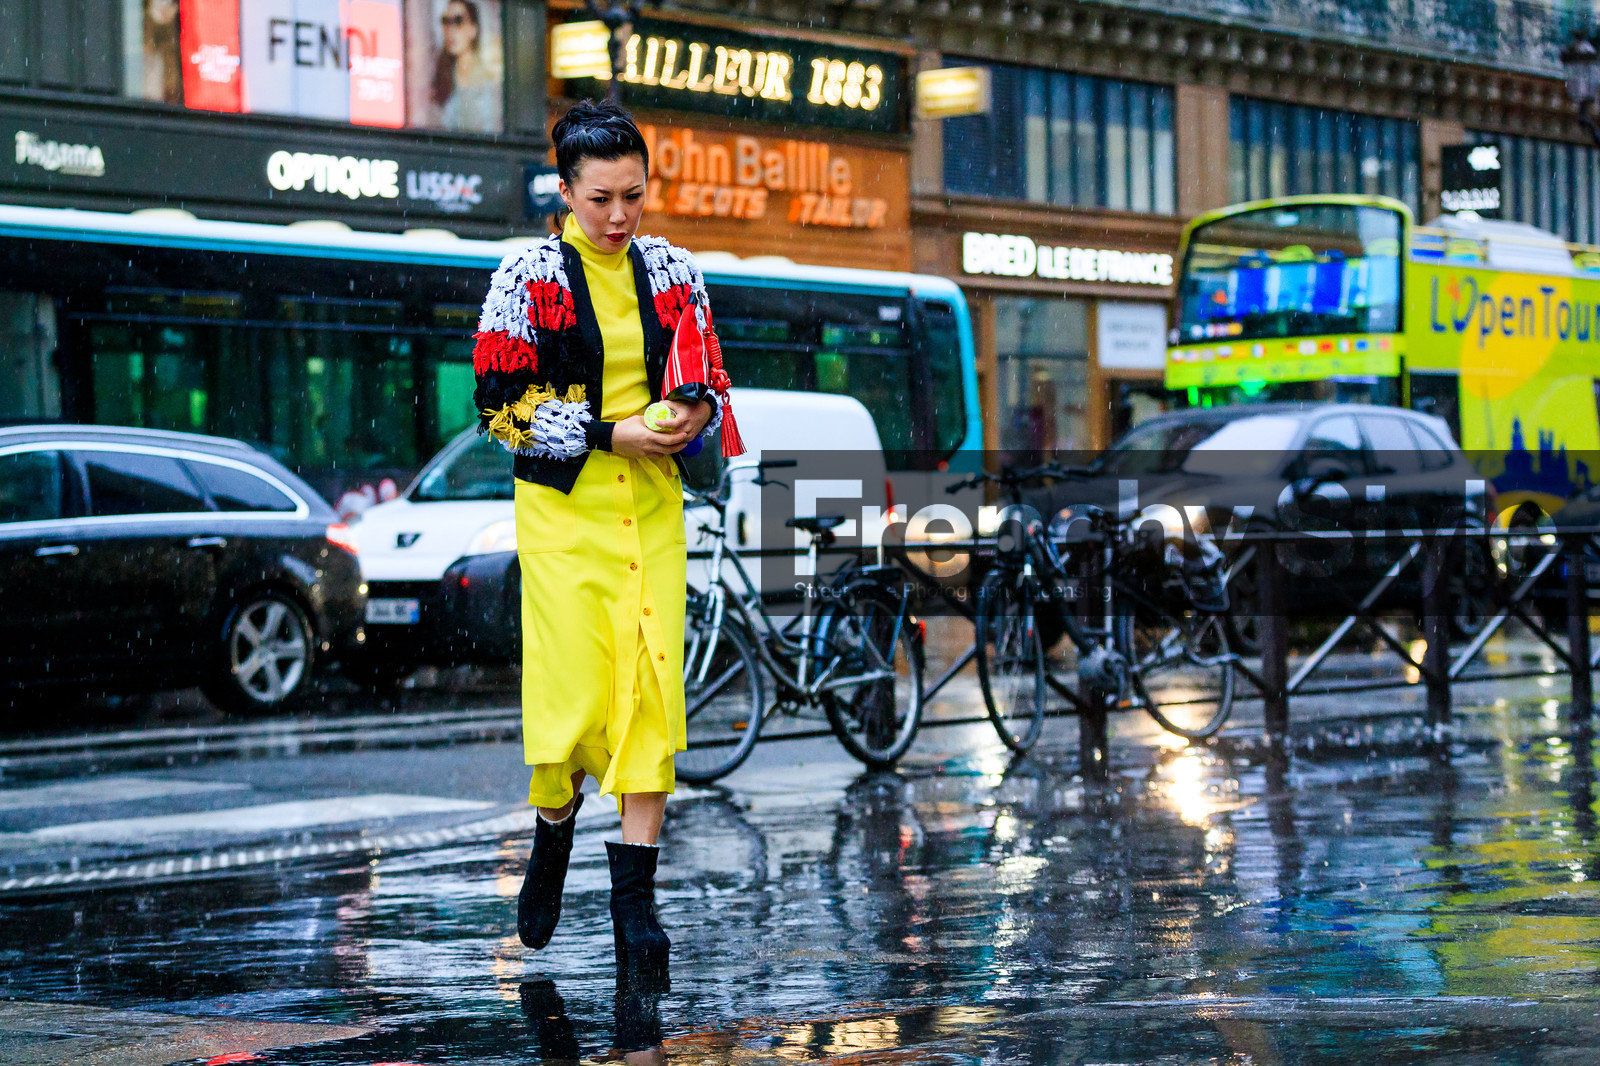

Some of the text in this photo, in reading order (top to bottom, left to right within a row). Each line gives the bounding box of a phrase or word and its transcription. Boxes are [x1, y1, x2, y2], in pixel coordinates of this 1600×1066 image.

[612, 33, 883, 112] AILLEUR 1883
[267, 150, 400, 200] OPTIQUE
[406, 169, 484, 205] LISSAC
[792, 193, 888, 229] TAILOR
[963, 231, 1037, 277] BRED
